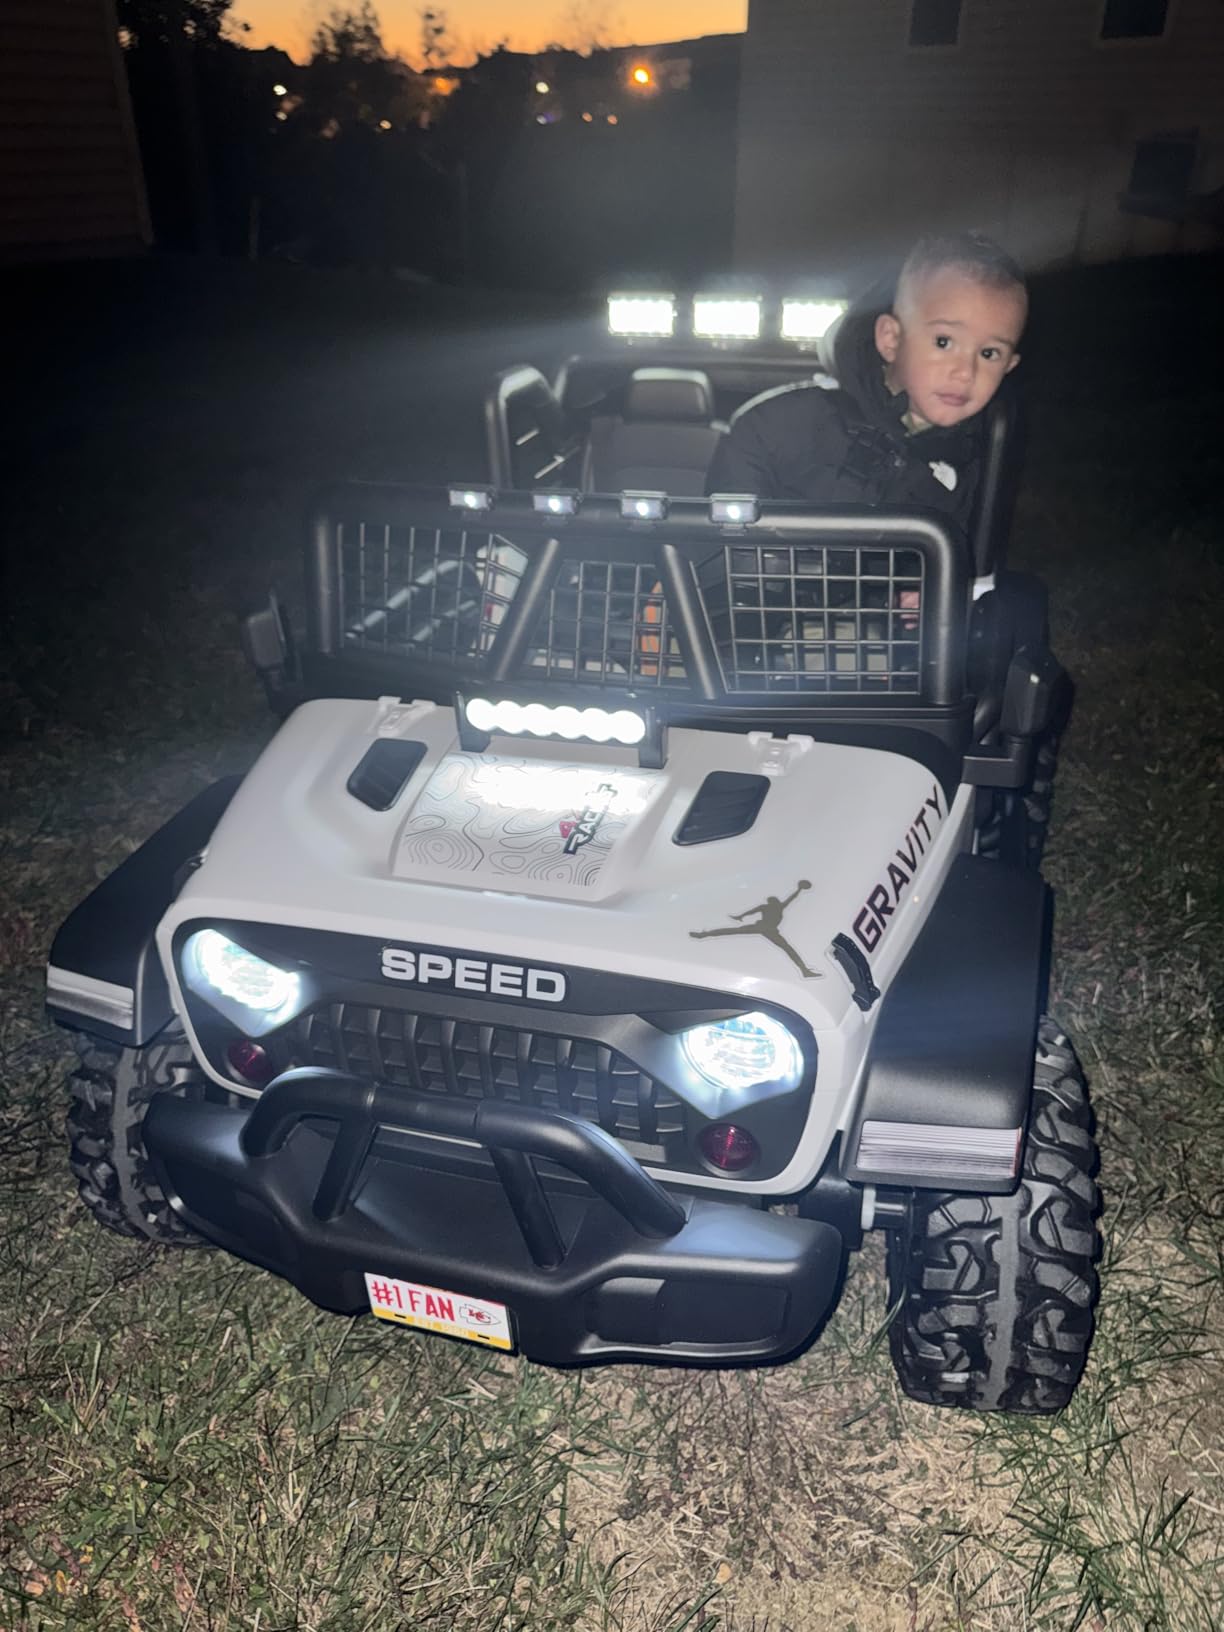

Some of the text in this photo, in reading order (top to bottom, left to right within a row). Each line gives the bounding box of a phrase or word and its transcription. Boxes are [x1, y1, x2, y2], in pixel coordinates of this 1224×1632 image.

[852, 784, 942, 953] GRAVITY
[380, 947, 567, 1003] SPEED
[371, 1279, 456, 1322] #1 FAN
